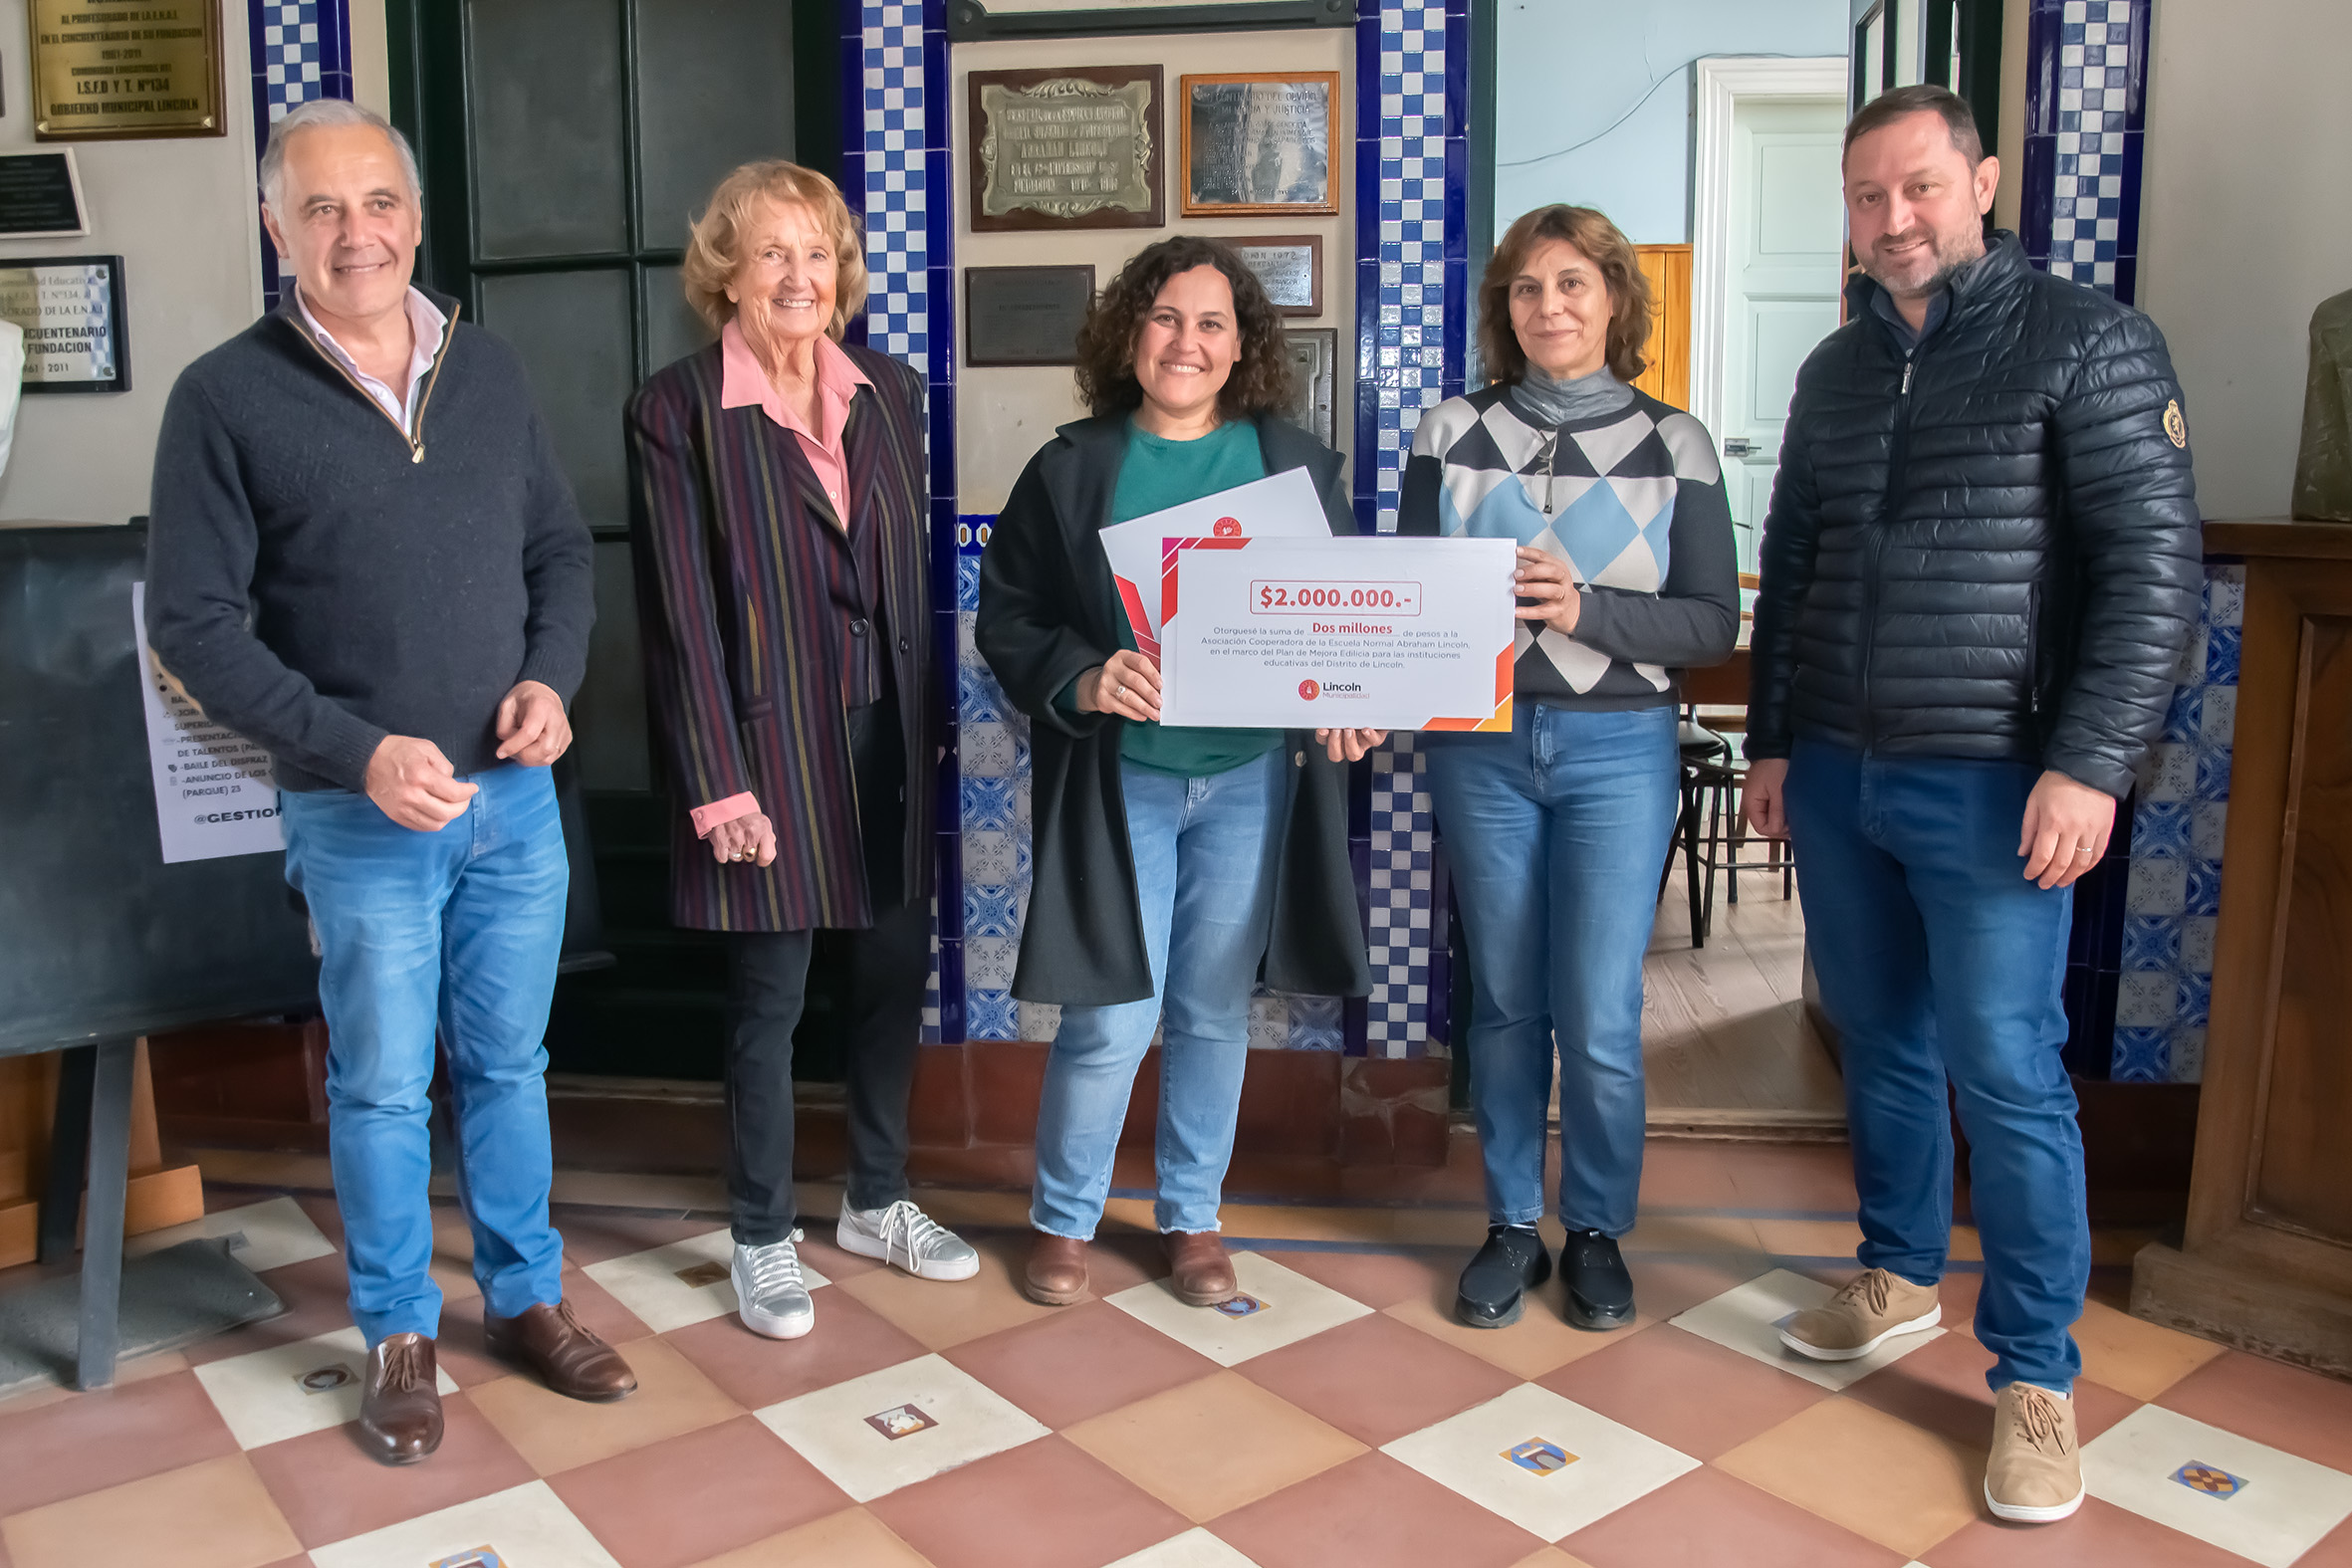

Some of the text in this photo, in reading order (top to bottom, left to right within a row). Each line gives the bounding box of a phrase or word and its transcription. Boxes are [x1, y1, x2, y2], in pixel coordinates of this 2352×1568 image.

[114, 80, 119, 93] Y
[102, 100, 155, 113] MUNICIPAL
[157, 99, 199, 112] LINCOLN
[24, 327, 107, 339] NCUENTENARIO
[28, 342, 92, 354] FUNDACION
[48, 363, 70, 372] 2011
[1260, 585, 1412, 608] $2.000.000.-
[1312, 622, 1335, 633] Dos
[1338, 622, 1393, 634] millones
[1249, 637, 1303, 647] Cooperadora
[1309, 649, 1337, 658] Mejora
[1339, 649, 1370, 658] Edilicia
[1322, 681, 1361, 692] Lincoln
[177, 749, 189, 758] DE
[192, 745, 239, 756] TALENTOS
[180, 761, 209, 771] -BAILE
[230, 756, 268, 767] DISFRAZ
[181, 773, 232, 784] -ANUNCIO
[234, 771, 246, 780] DE
[249, 769, 267, 779] LOS
[182, 784, 242, 799] (PARQUE) 23
